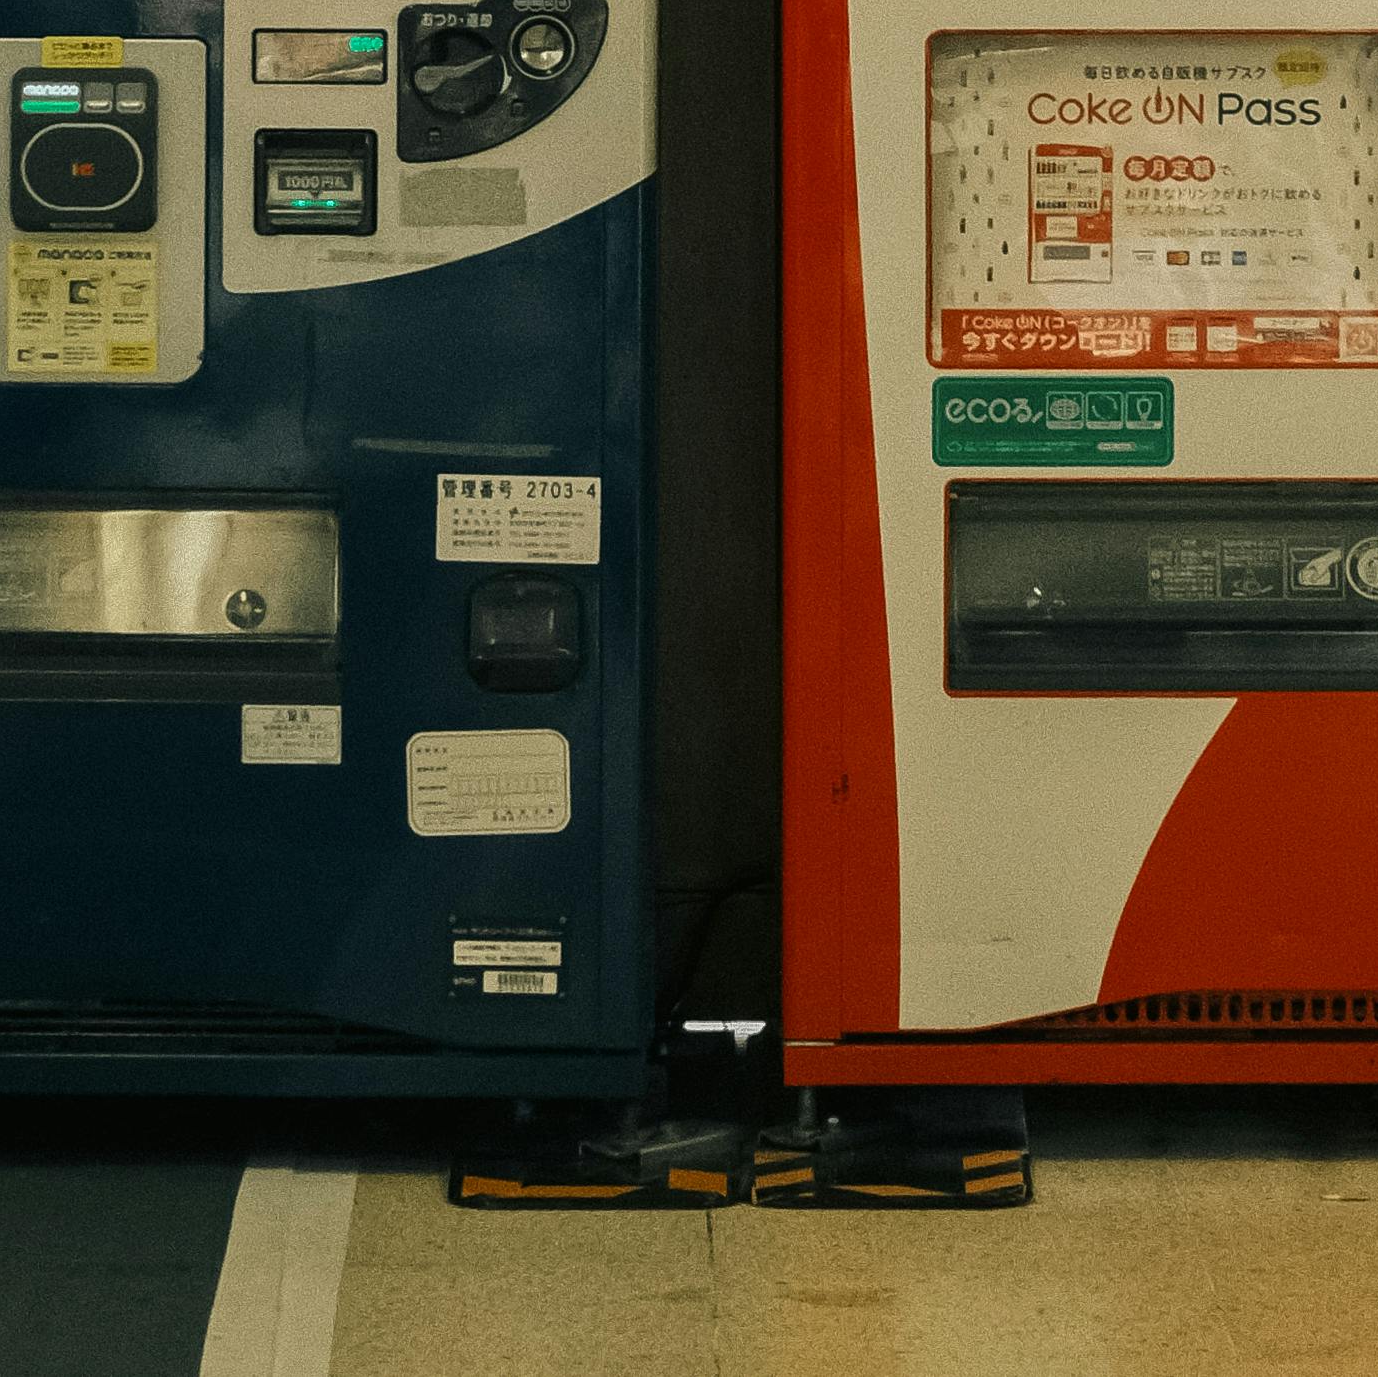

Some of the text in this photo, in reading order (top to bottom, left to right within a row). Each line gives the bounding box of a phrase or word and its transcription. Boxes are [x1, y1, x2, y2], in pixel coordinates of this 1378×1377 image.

[1085, 65, 1267, 80] 毎日飲める自販機サブスク
[1028, 86, 1322, 125] Coke ON Pass
[443, 479, 596, 499] 管理番号 2703-4
